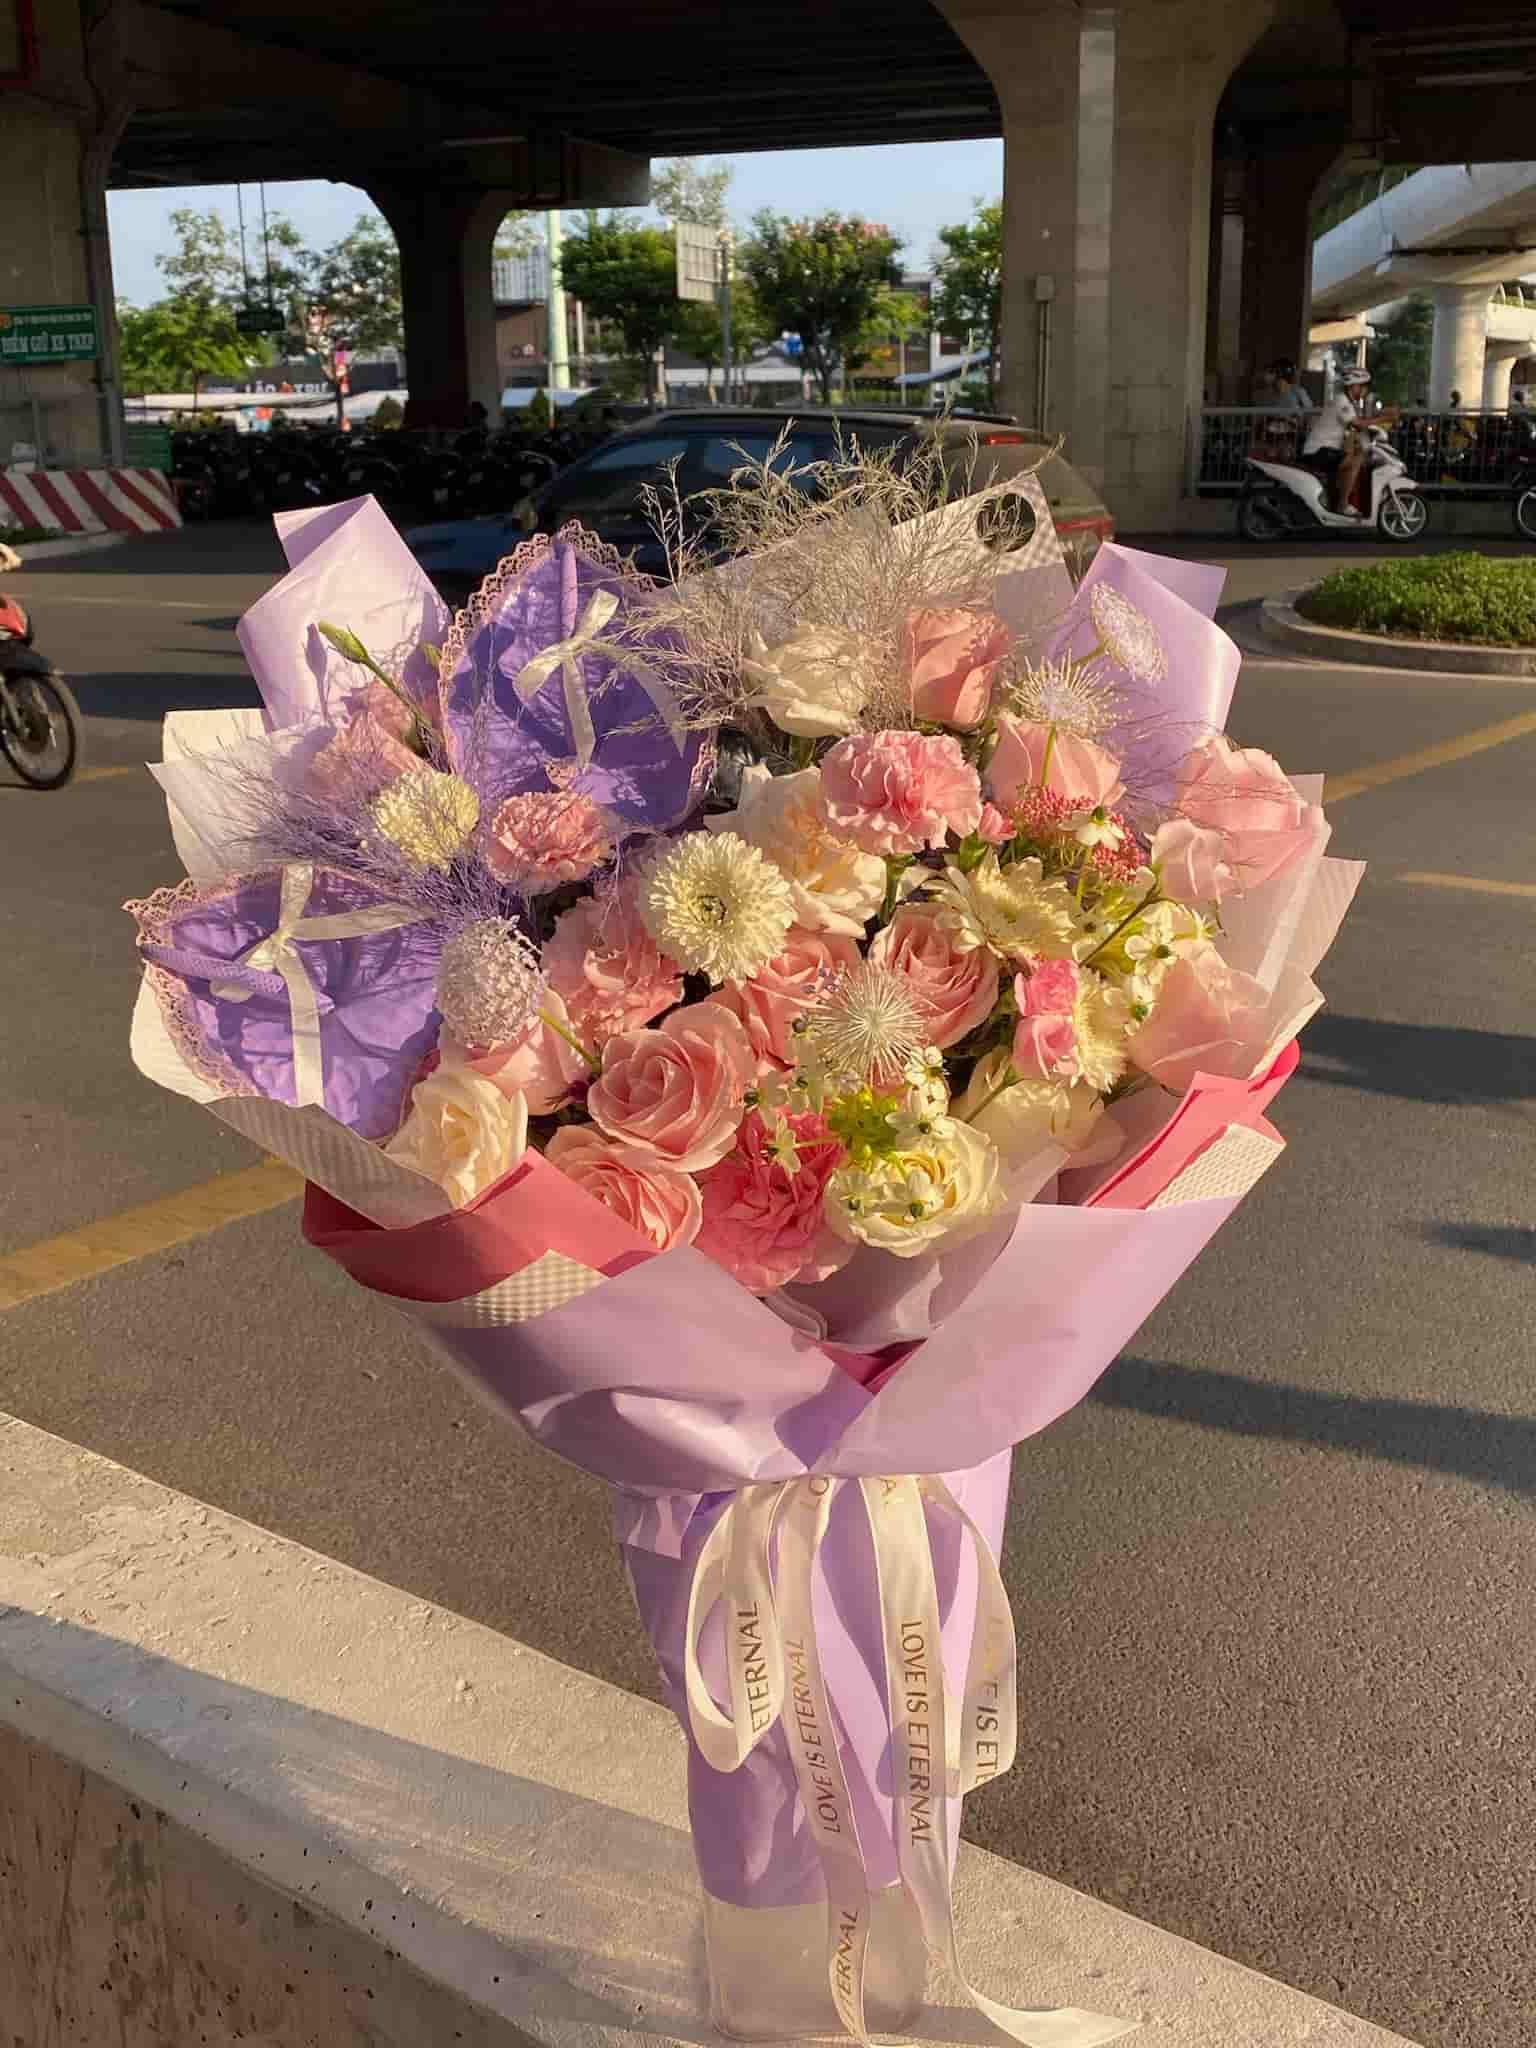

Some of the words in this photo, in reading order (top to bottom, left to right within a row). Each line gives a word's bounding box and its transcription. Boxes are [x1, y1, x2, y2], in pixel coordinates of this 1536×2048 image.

[737, 1599, 770, 1733] ETERNAL
[901, 1620, 928, 1684] LOVE
[786, 1639, 823, 1747] ETERNAL
[905, 1691, 929, 1713] IS
[975, 1704, 999, 1732] IS
[805, 1751, 826, 1769] IS
[907, 1721, 932, 1847] ETERNAL
[812, 1772, 841, 1833] LOVE
